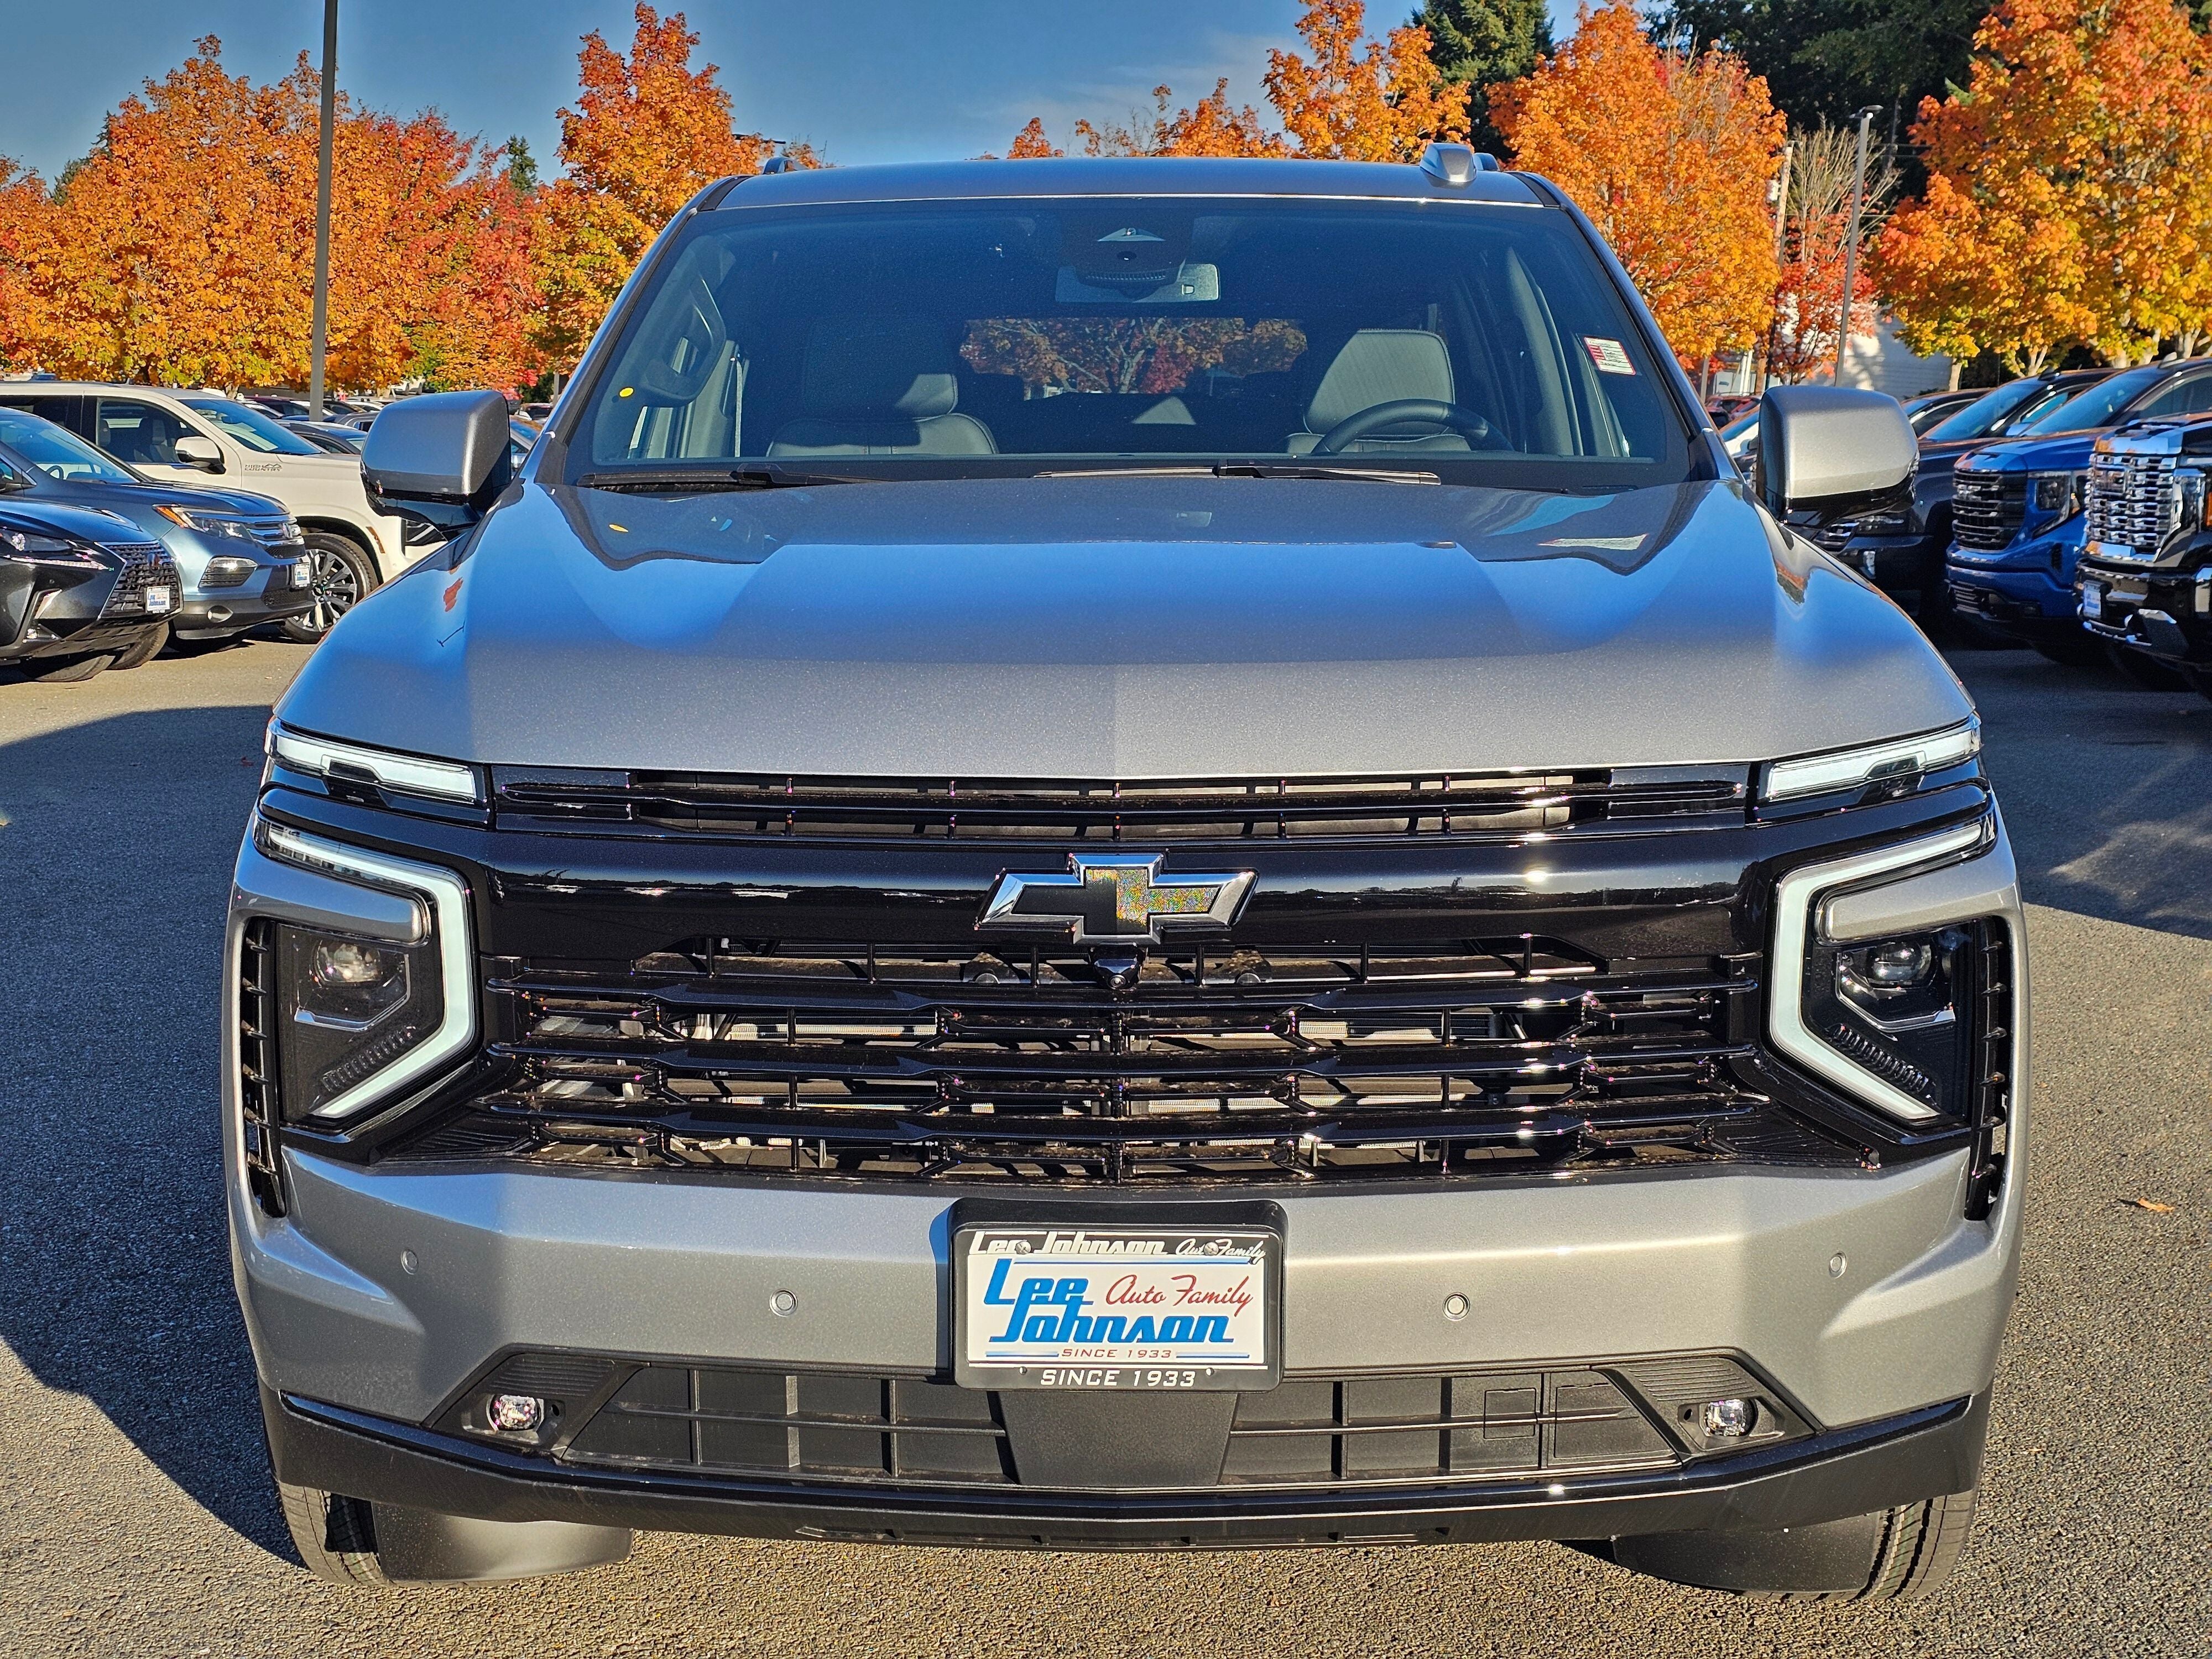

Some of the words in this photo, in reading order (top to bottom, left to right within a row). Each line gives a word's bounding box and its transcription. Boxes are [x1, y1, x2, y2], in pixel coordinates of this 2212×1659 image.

[1034, 1231, 1168, 1255] Johnson
[1176, 1238, 1212, 1255] Aut
[1215, 1238, 1266, 1264] Family
[984, 1259, 1094, 1305] Lee
[1106, 1274, 1167, 1305] Auto
[1171, 1274, 1254, 1317] Family
[988, 1296, 1234, 1343] Johnson
[1062, 1349, 1118, 1358] SINCE
[1128, 1349, 1172, 1358] 1933
[1040, 1369, 1120, 1386] SINCE
[1134, 1370, 1196, 1387] 1933
